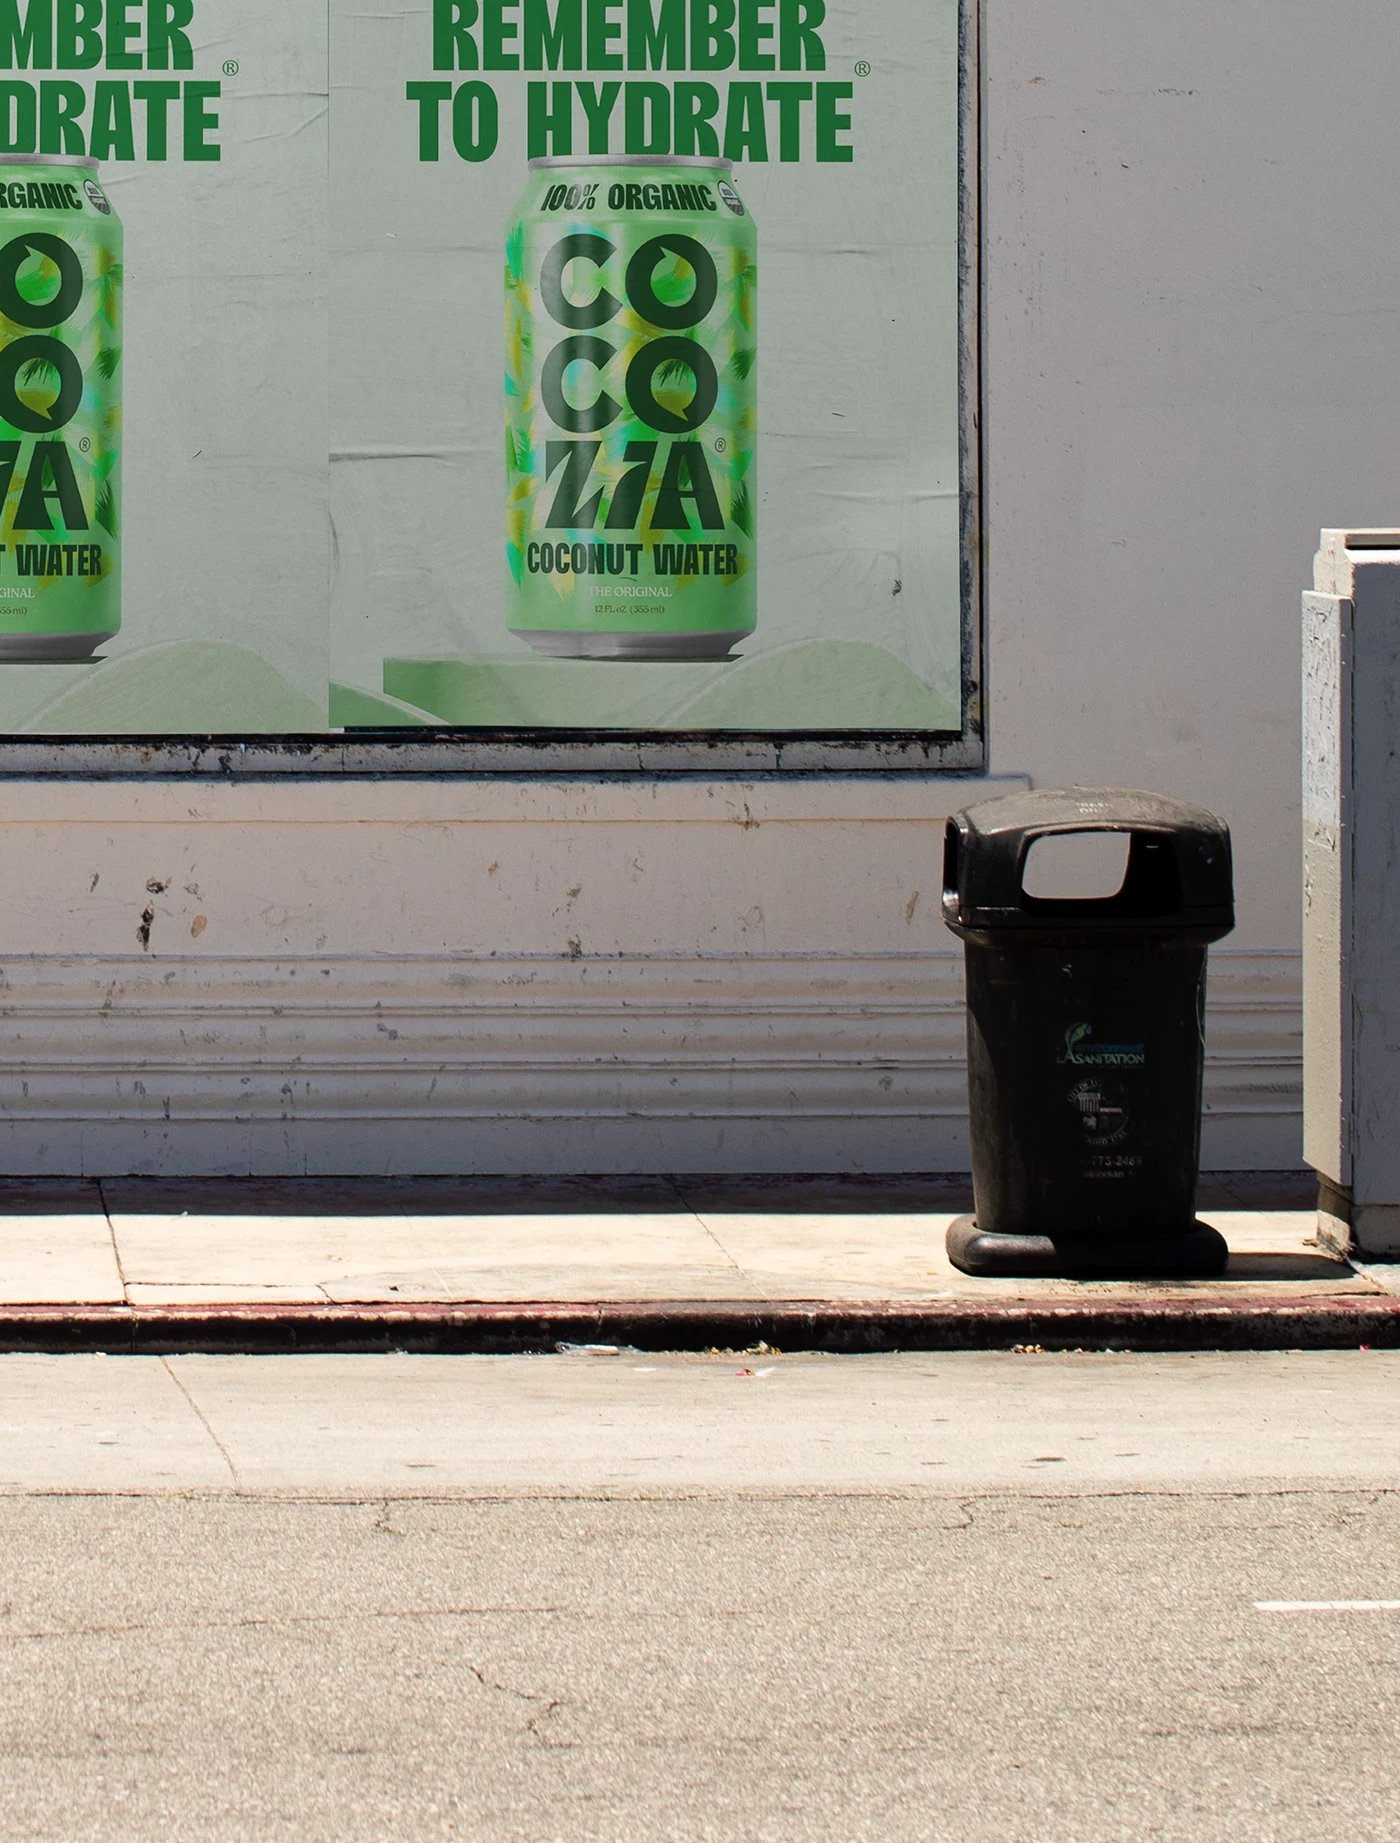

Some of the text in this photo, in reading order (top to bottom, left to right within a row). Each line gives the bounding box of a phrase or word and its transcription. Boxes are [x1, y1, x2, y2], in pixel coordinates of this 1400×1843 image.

[406, 81, 499, 162] TO
[526, 81, 854, 162] HYDRATE
[540, 184, 599, 211] 100%
[608, 183, 717, 212] ORGANIC
[540, 233, 717, 331] CO
[540, 335, 717, 434] CO
[16, 543, 102, 576] WATER
[526, 542, 738, 576] COCONUT WATER
[588, 586, 672, 598] THE ORIGINAL
